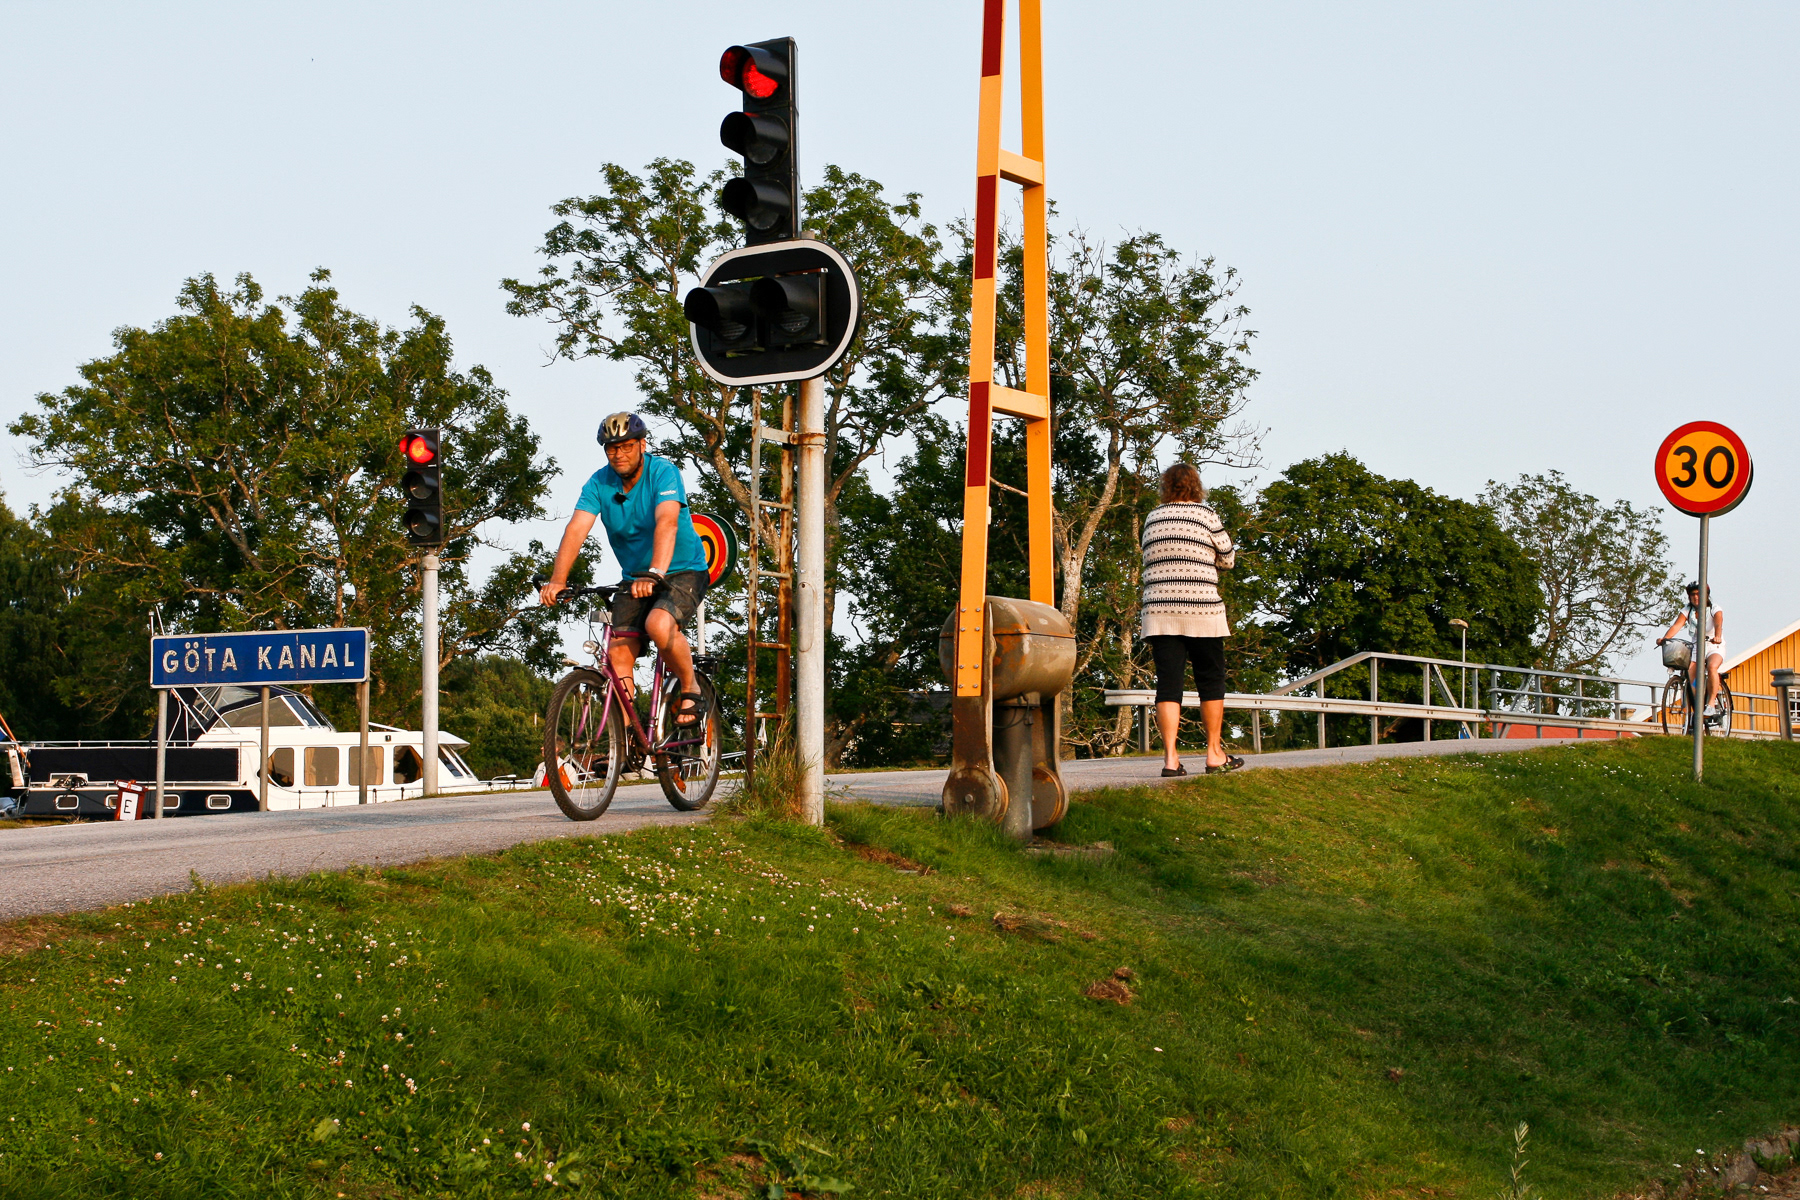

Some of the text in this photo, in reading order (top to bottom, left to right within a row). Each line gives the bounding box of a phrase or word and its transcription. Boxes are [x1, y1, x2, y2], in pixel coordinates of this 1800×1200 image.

[1671, 445, 1735, 489] 30
[162, 641, 355, 674] GÖTA KANAL
[123, 799, 133, 814] E
